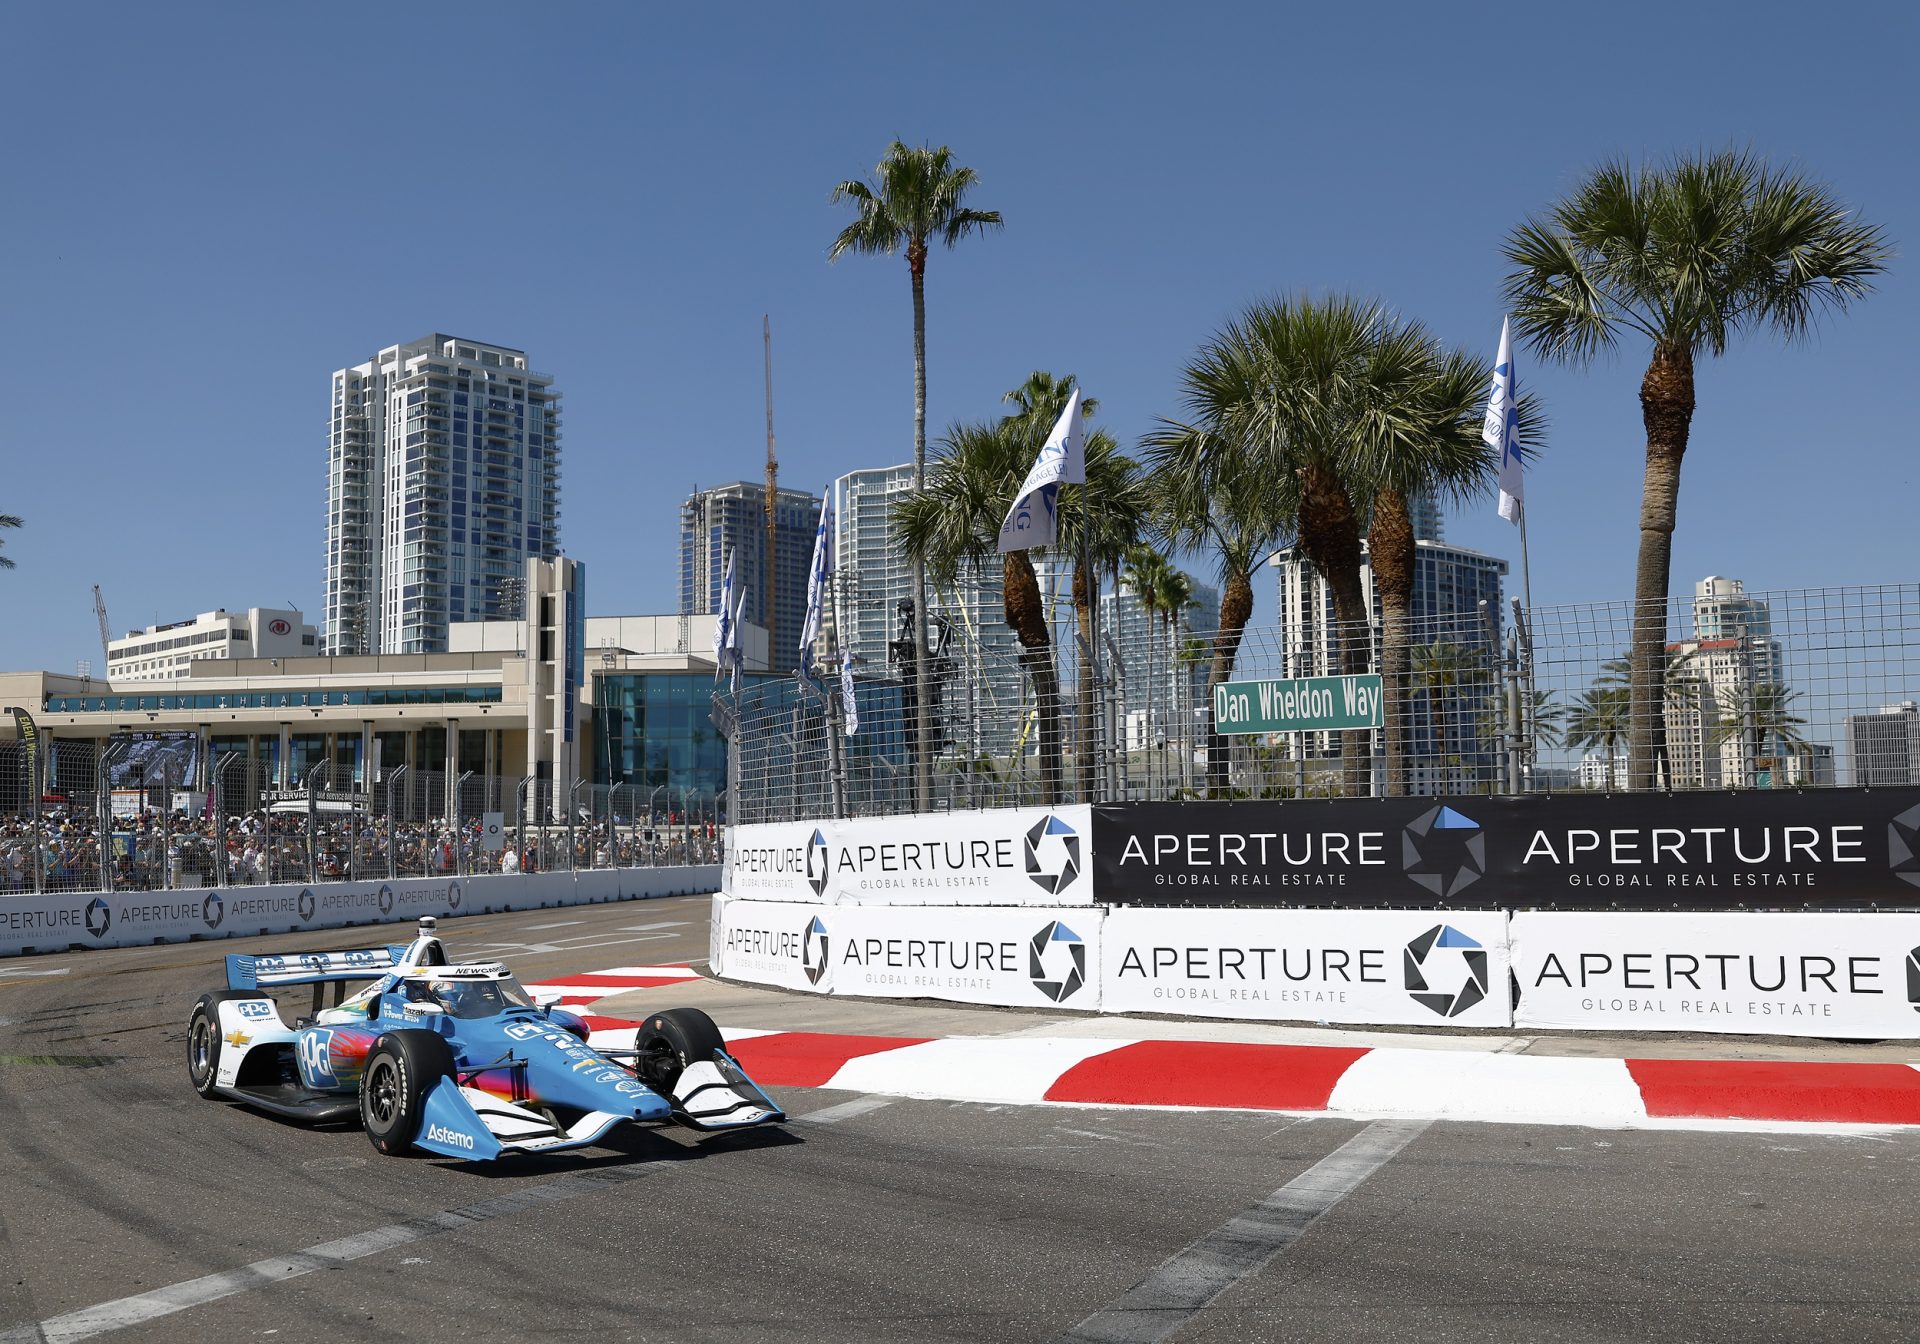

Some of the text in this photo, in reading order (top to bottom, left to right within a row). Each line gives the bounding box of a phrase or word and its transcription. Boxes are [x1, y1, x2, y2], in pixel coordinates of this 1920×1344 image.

[1019, 466, 1053, 496] RTGAGE
[41, 694, 348, 709] MAHAFFEY THEATER
[1218, 678, 1379, 726] Dan Wheldon Way
[1120, 832, 1385, 865] APERTURE
[1523, 826, 1866, 864] APERTURE
[734, 848, 803, 873] APERTURE
[838, 840, 1013, 873] APERTURE
[742, 879, 793, 888] GLOBAL REAL ESTATE
[861, 877, 988, 889] GLOBAL REAL ESTATE
[1155, 874, 1345, 886] GLOBAL REAL ESTATE
[1569, 874, 1814, 886] GLOBAL REAL ESTATE
[322, 894, 376, 909] APERTURE
[398, 889, 446, 903] APERTURE
[120, 904, 199, 922] APERTURE
[231, 898, 295, 915] APERTURE
[0, 910, 80, 928] PERTURE
[727, 929, 798, 958] APERTURE
[346, 952, 374, 966] PPG
[844, 939, 1017, 971] APERTURE
[1119, 947, 1386, 982] APERTURE
[1535, 953, 1883, 993] APERTURE
[866, 974, 990, 990] GLOBAL REAL ESTATE
[1154, 988, 1345, 1003] GLOBAL REAL ESTATE
[239, 1003, 269, 1016] PPG
[1582, 999, 1831, 1017] GLOBAL REAL ESTATE
[301, 1032, 332, 1082] PPG
[398, 1057, 408, 1117] Firestone
[427, 1123, 474, 1150] Astemo
